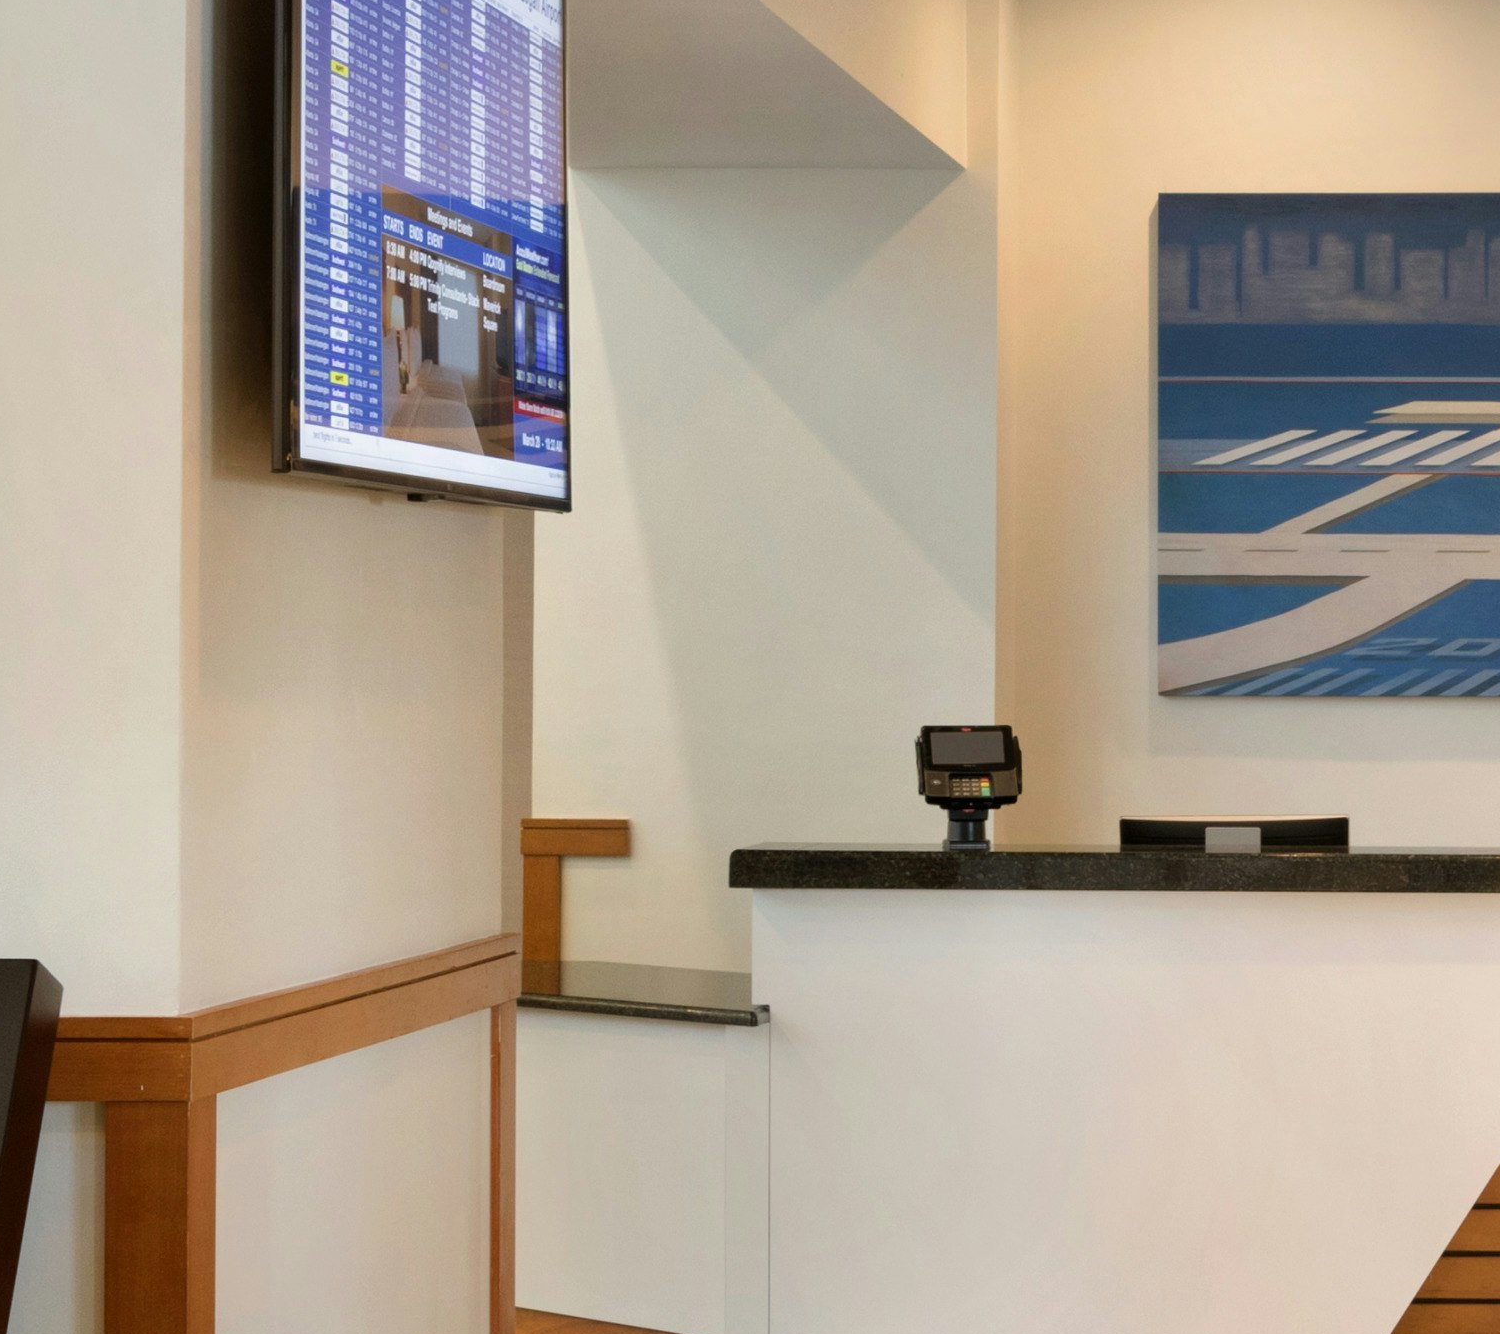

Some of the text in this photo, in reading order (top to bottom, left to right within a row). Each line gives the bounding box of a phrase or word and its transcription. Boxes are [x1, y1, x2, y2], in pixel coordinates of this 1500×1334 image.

[383, 214, 405, 235] STARTS
[409, 224, 423, 243] ENDS
[427, 231, 443, 249] EVENT
[483, 252, 506, 272] LOCATION
